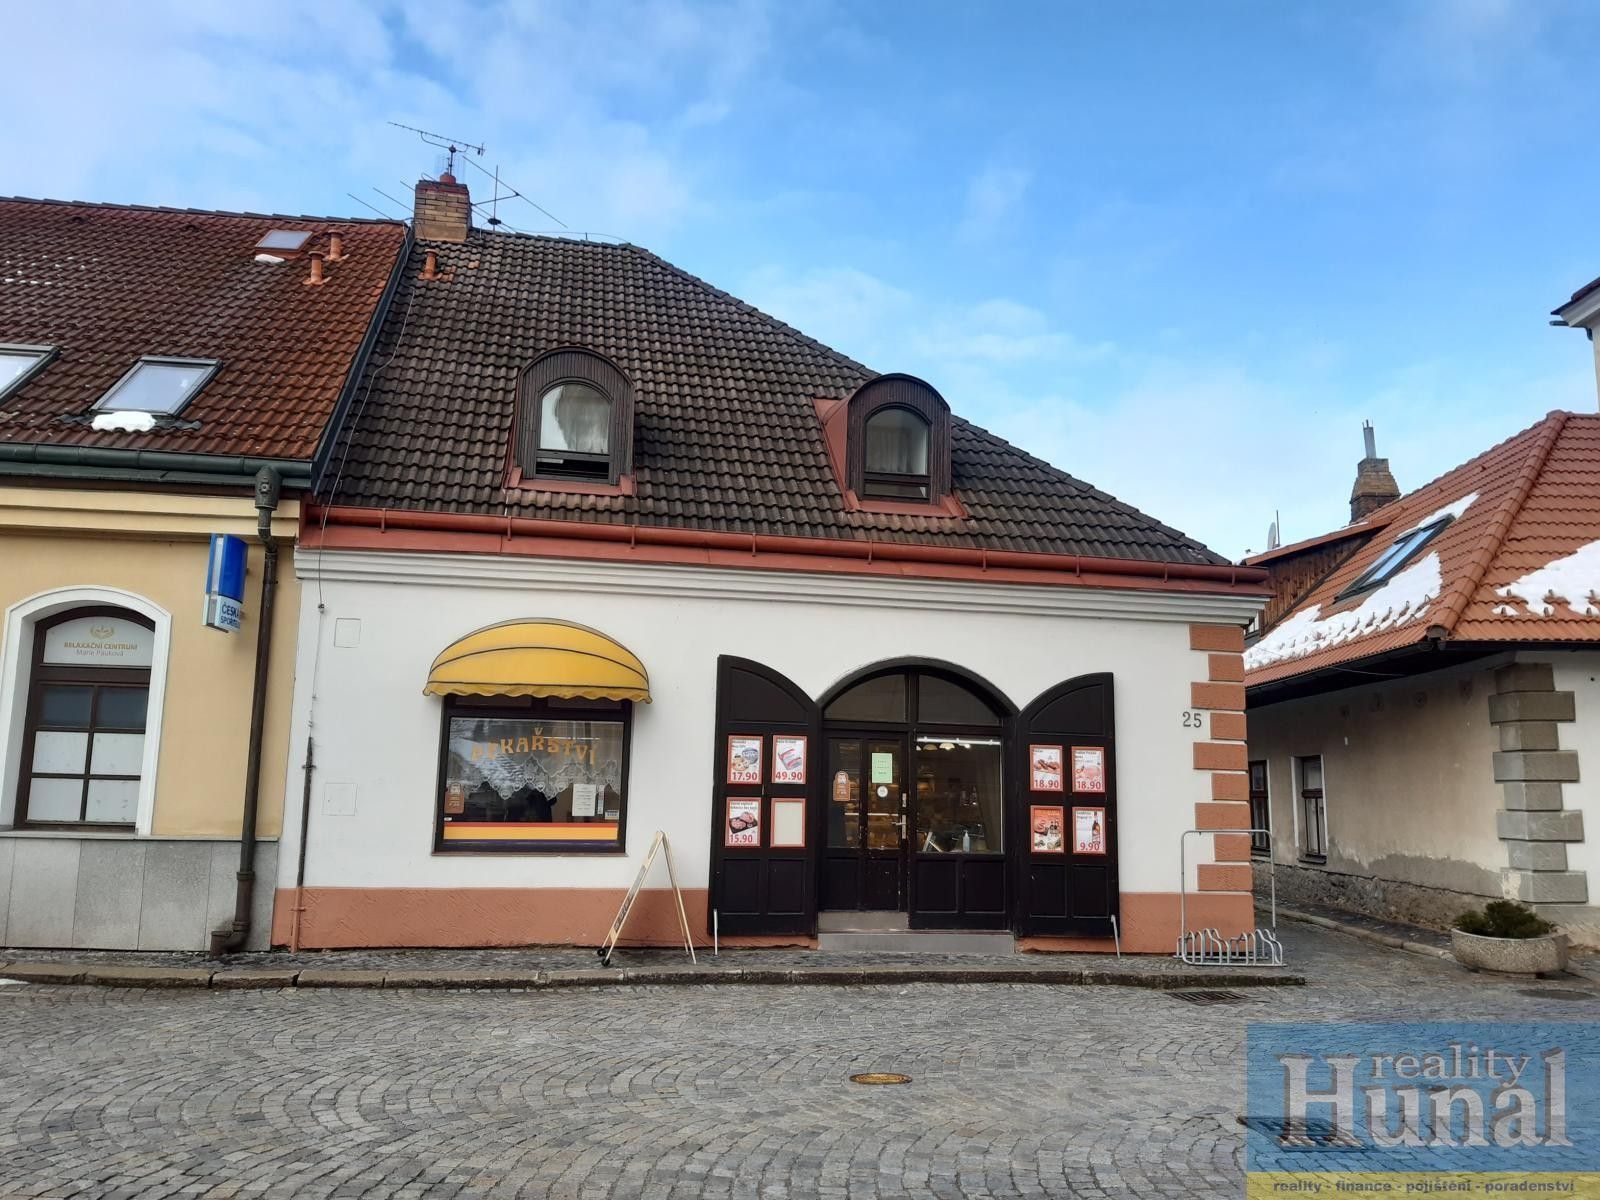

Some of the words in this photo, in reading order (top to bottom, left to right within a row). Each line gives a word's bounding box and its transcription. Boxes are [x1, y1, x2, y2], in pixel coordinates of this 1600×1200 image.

[104, 643, 138, 651] CENTRUM
[1182, 711, 1202, 728] 25
[732, 771, 757, 782] 17.90
[775, 771, 803, 782] 49.90
[1034, 779, 1060, 789] 18.90
[1076, 781, 1101, 790] 18.90
[729, 834, 753, 844] 15.90
[1079, 841, 1100, 851] 9.90
